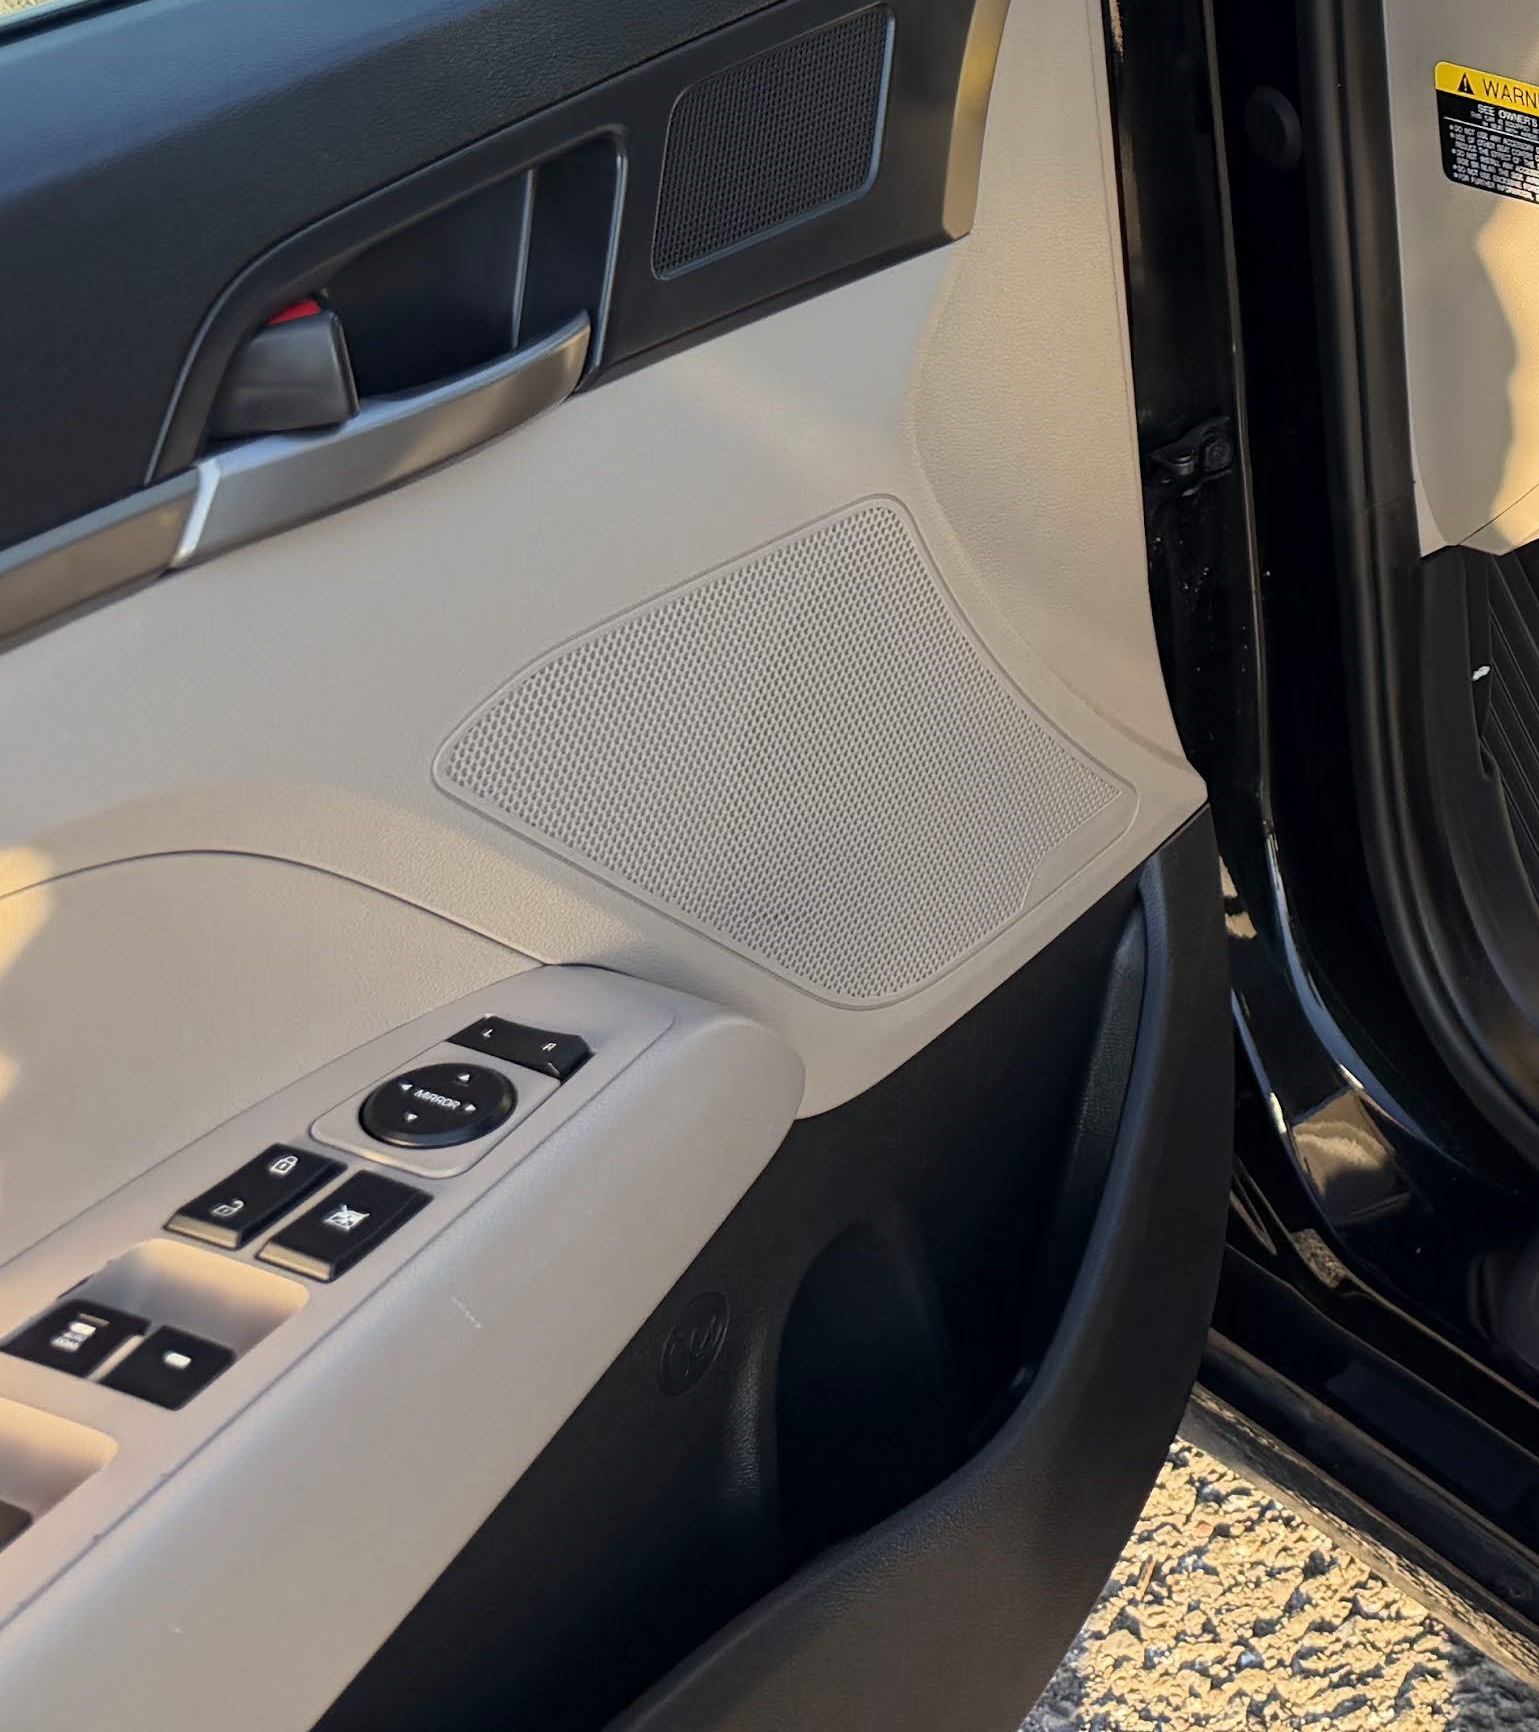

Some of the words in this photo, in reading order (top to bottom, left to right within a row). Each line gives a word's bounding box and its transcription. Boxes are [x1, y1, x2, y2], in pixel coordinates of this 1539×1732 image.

[1477, 103, 1496, 117] SEE
[1498, 109, 1538, 128] OWNER'S
[483, 1028, 494, 1038] L
[542, 1042, 557, 1052] R
[413, 1088, 461, 1110] MIRROR
